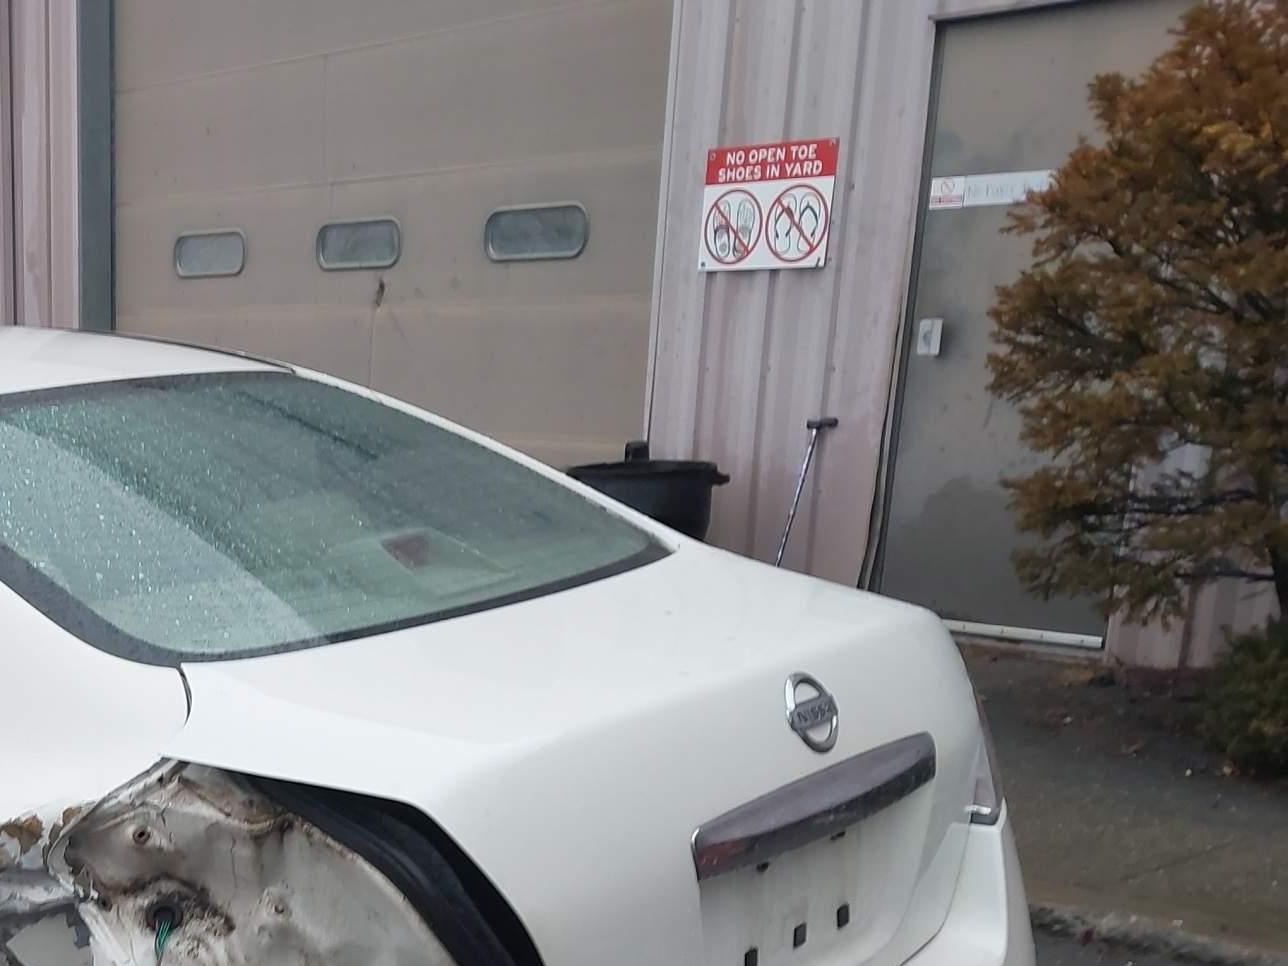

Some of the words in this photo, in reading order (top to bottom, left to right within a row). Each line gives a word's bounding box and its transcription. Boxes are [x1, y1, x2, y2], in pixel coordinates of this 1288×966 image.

[726, 150, 745, 166] NO
[748, 147, 786, 165] OPEN
[790, 143, 818, 160] TOE
[718, 165, 762, 183] SHOES
[766, 163, 780, 178] IN
[785, 159, 823, 176] YARD
